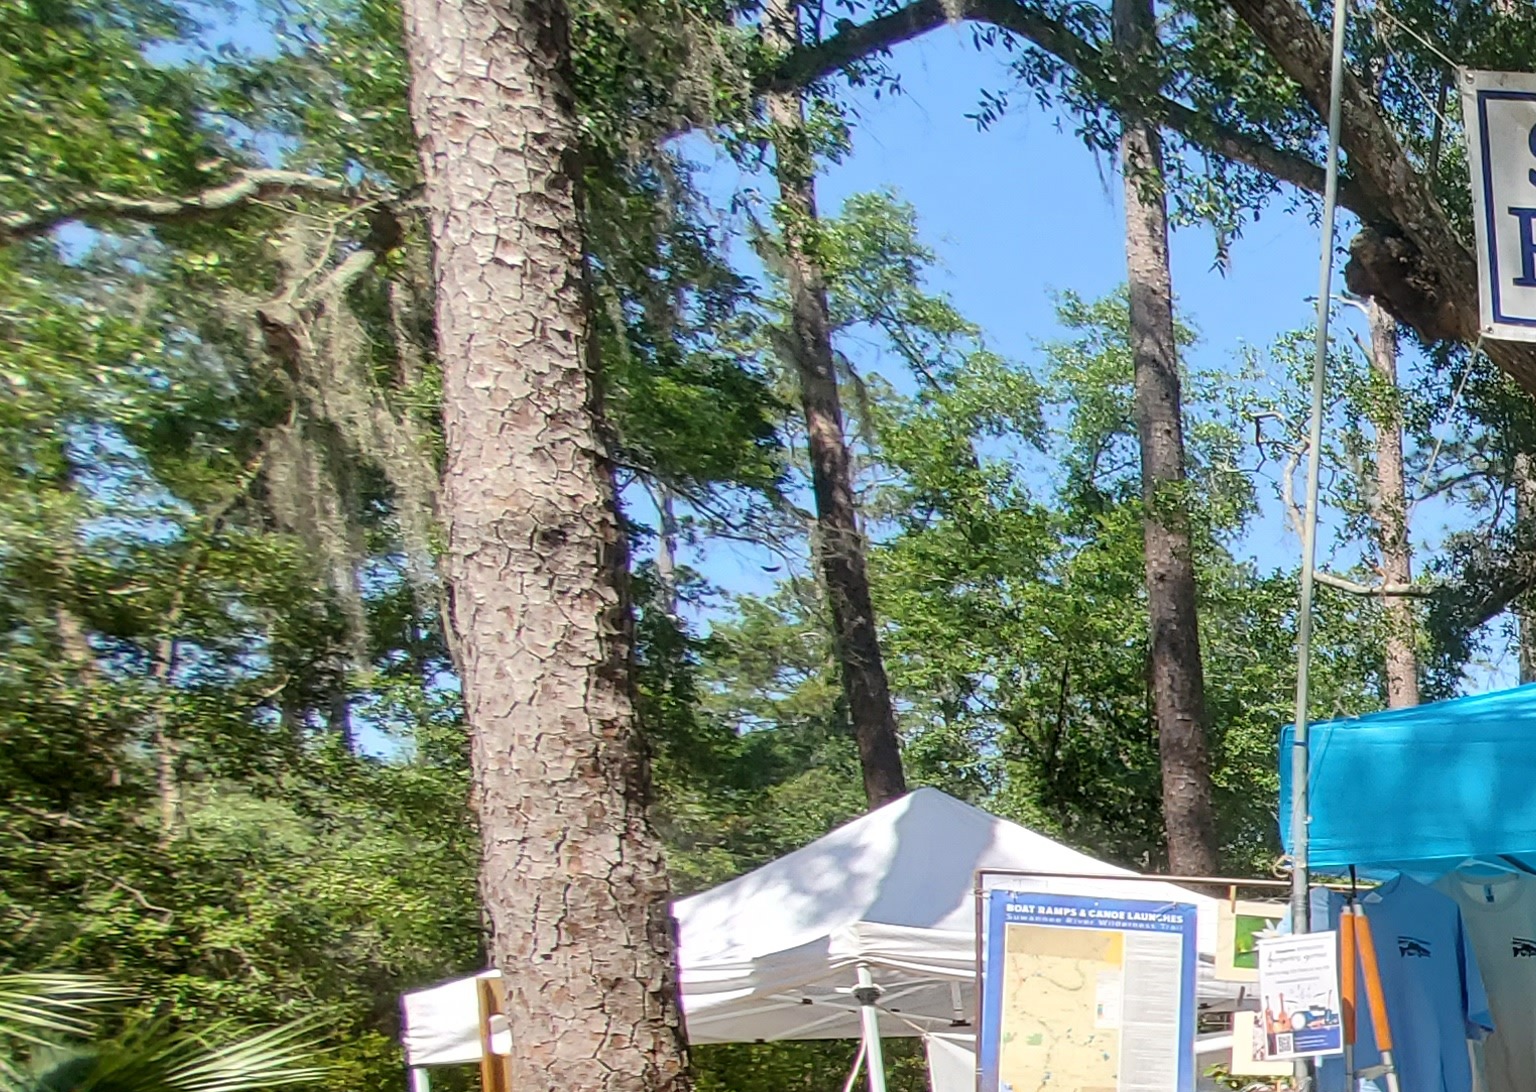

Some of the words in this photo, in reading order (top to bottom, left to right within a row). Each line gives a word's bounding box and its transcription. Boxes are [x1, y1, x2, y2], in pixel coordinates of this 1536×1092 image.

[1006, 903, 1036, 914] BOAT
[1038, 905, 1078, 917] RAMPS
[1088, 910, 1126, 920] CANOE
